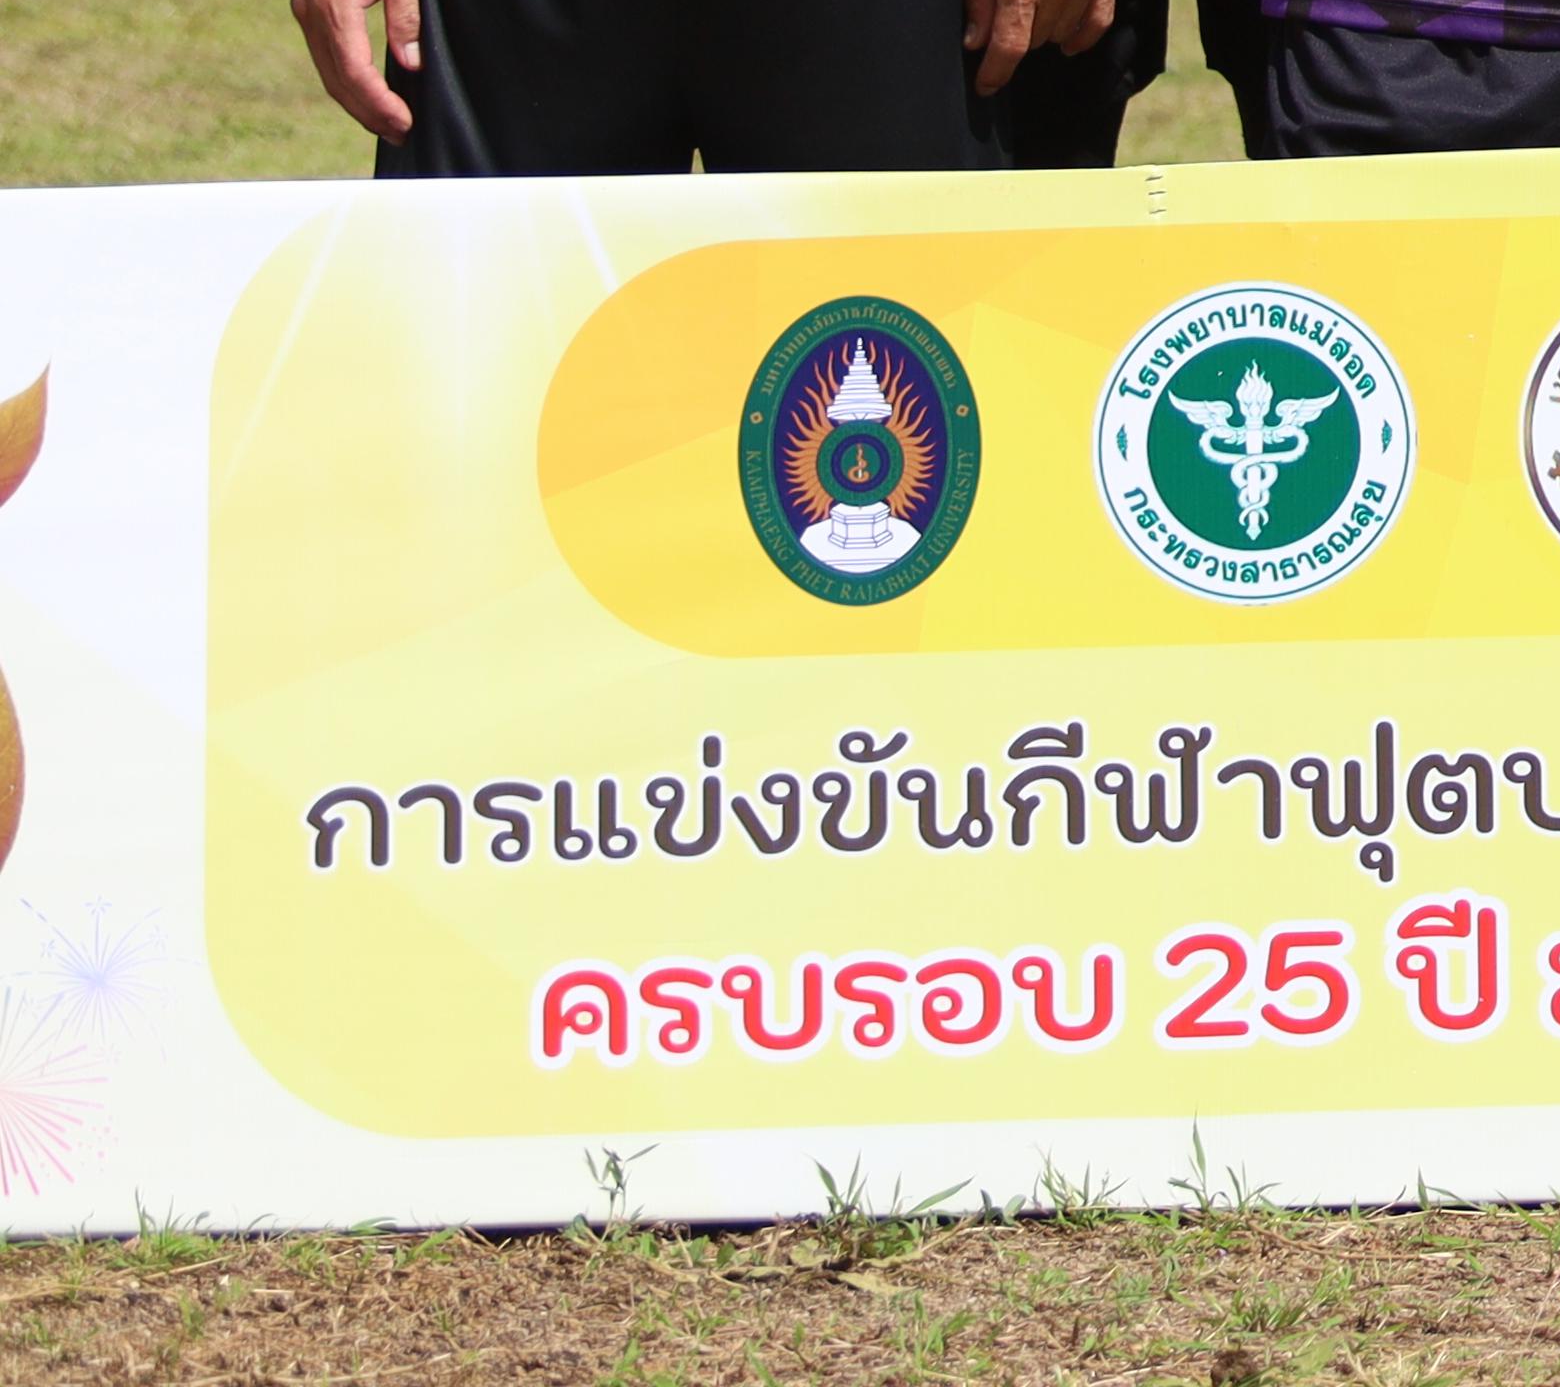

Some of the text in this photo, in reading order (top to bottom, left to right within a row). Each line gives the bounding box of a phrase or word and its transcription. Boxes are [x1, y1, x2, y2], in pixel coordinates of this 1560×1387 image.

[1119, 302, 1376, 400] โรงพยาบาลแม่สอด
[746, 448, 975, 602] KAMPHAENG PHET RAJABHAT UNIVERSITY
[1124, 480, 1387, 584] กระทรวงสาธารณสุข
[541, 952, 1113, 1057] ครบรอบ
[1166, 929, 1349, 1038] 25
[1395, 898, 1497, 1031] ปี
